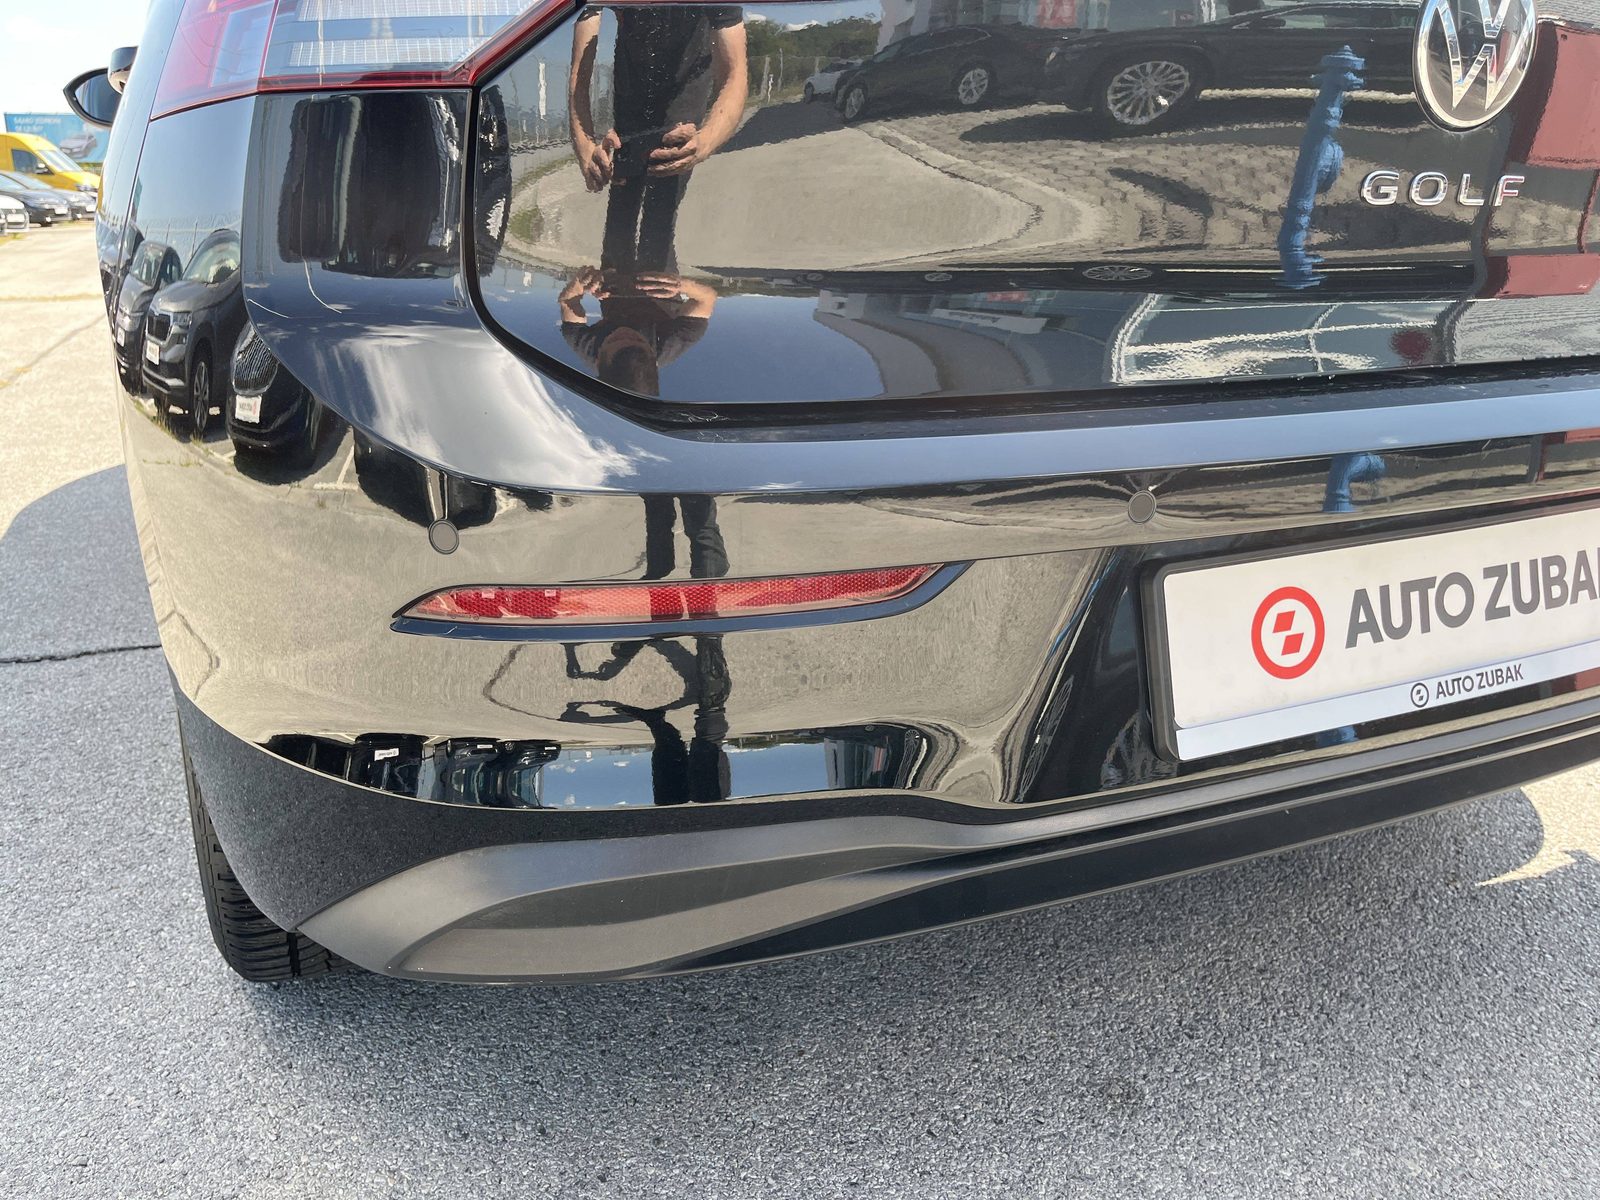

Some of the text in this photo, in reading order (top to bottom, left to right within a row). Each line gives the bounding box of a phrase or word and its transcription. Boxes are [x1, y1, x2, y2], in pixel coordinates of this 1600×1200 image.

[1361, 170, 1525, 206] GOLF
[1345, 547, 1600, 649] AUTO ZUBA
[1436, 663, 1524, 699] AUTO ZUBAK
